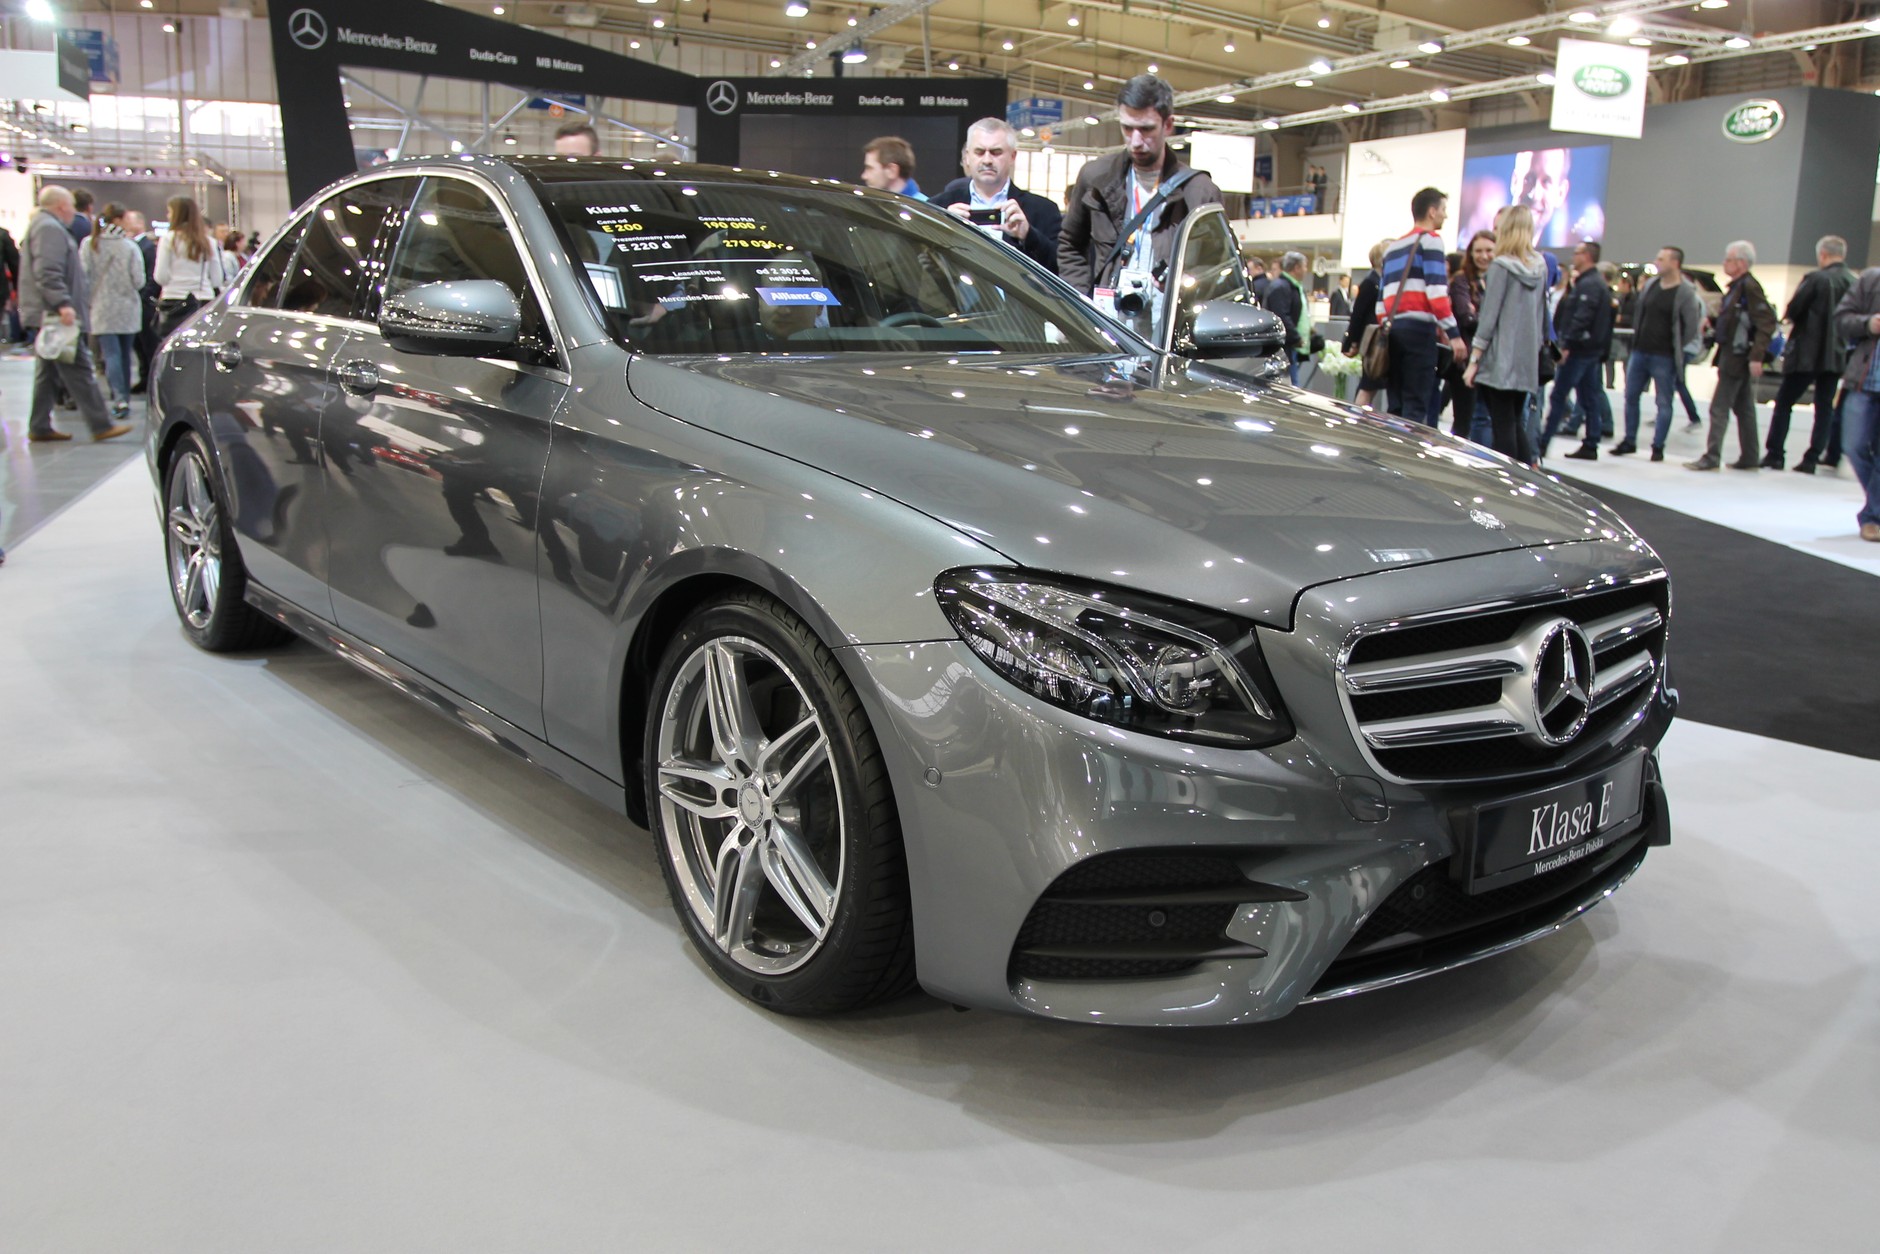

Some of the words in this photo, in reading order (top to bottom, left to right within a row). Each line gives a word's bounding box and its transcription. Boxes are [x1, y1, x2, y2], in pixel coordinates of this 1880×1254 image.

[337, 26, 438, 55] Mercedes-Benz
[469, 48, 518, 65] Duda-Cars
[536, 56, 551, 68] MB
[552, 58, 584, 73] Motors
[746, 91, 834, 105] Mercedes-Benz
[858, 95, 904, 106] Duda-Cars
[920, 96, 935, 105] MB
[936, 96, 969, 107] Motors
[586, 207, 629, 215] Klasa
[629, 204, 643, 213] E
[601, 225, 614, 233] E
[614, 223, 643, 232] 200
[703, 221, 729, 229] 190
[729, 221, 757, 230] 000
[617, 243, 630, 252] E
[630, 241, 660, 251] 220
[661, 241, 673, 250] d
[722, 240, 750, 248] 278
[657, 294, 726, 303] Mercedes-Benz
[770, 291, 812, 301] Allianz
[1526, 801, 1593, 856] Klasa
[1597, 782, 1613, 828] E
[1533, 848, 1585, 876] Mercedes-Benz
[1584, 837, 1604, 855] Polska
